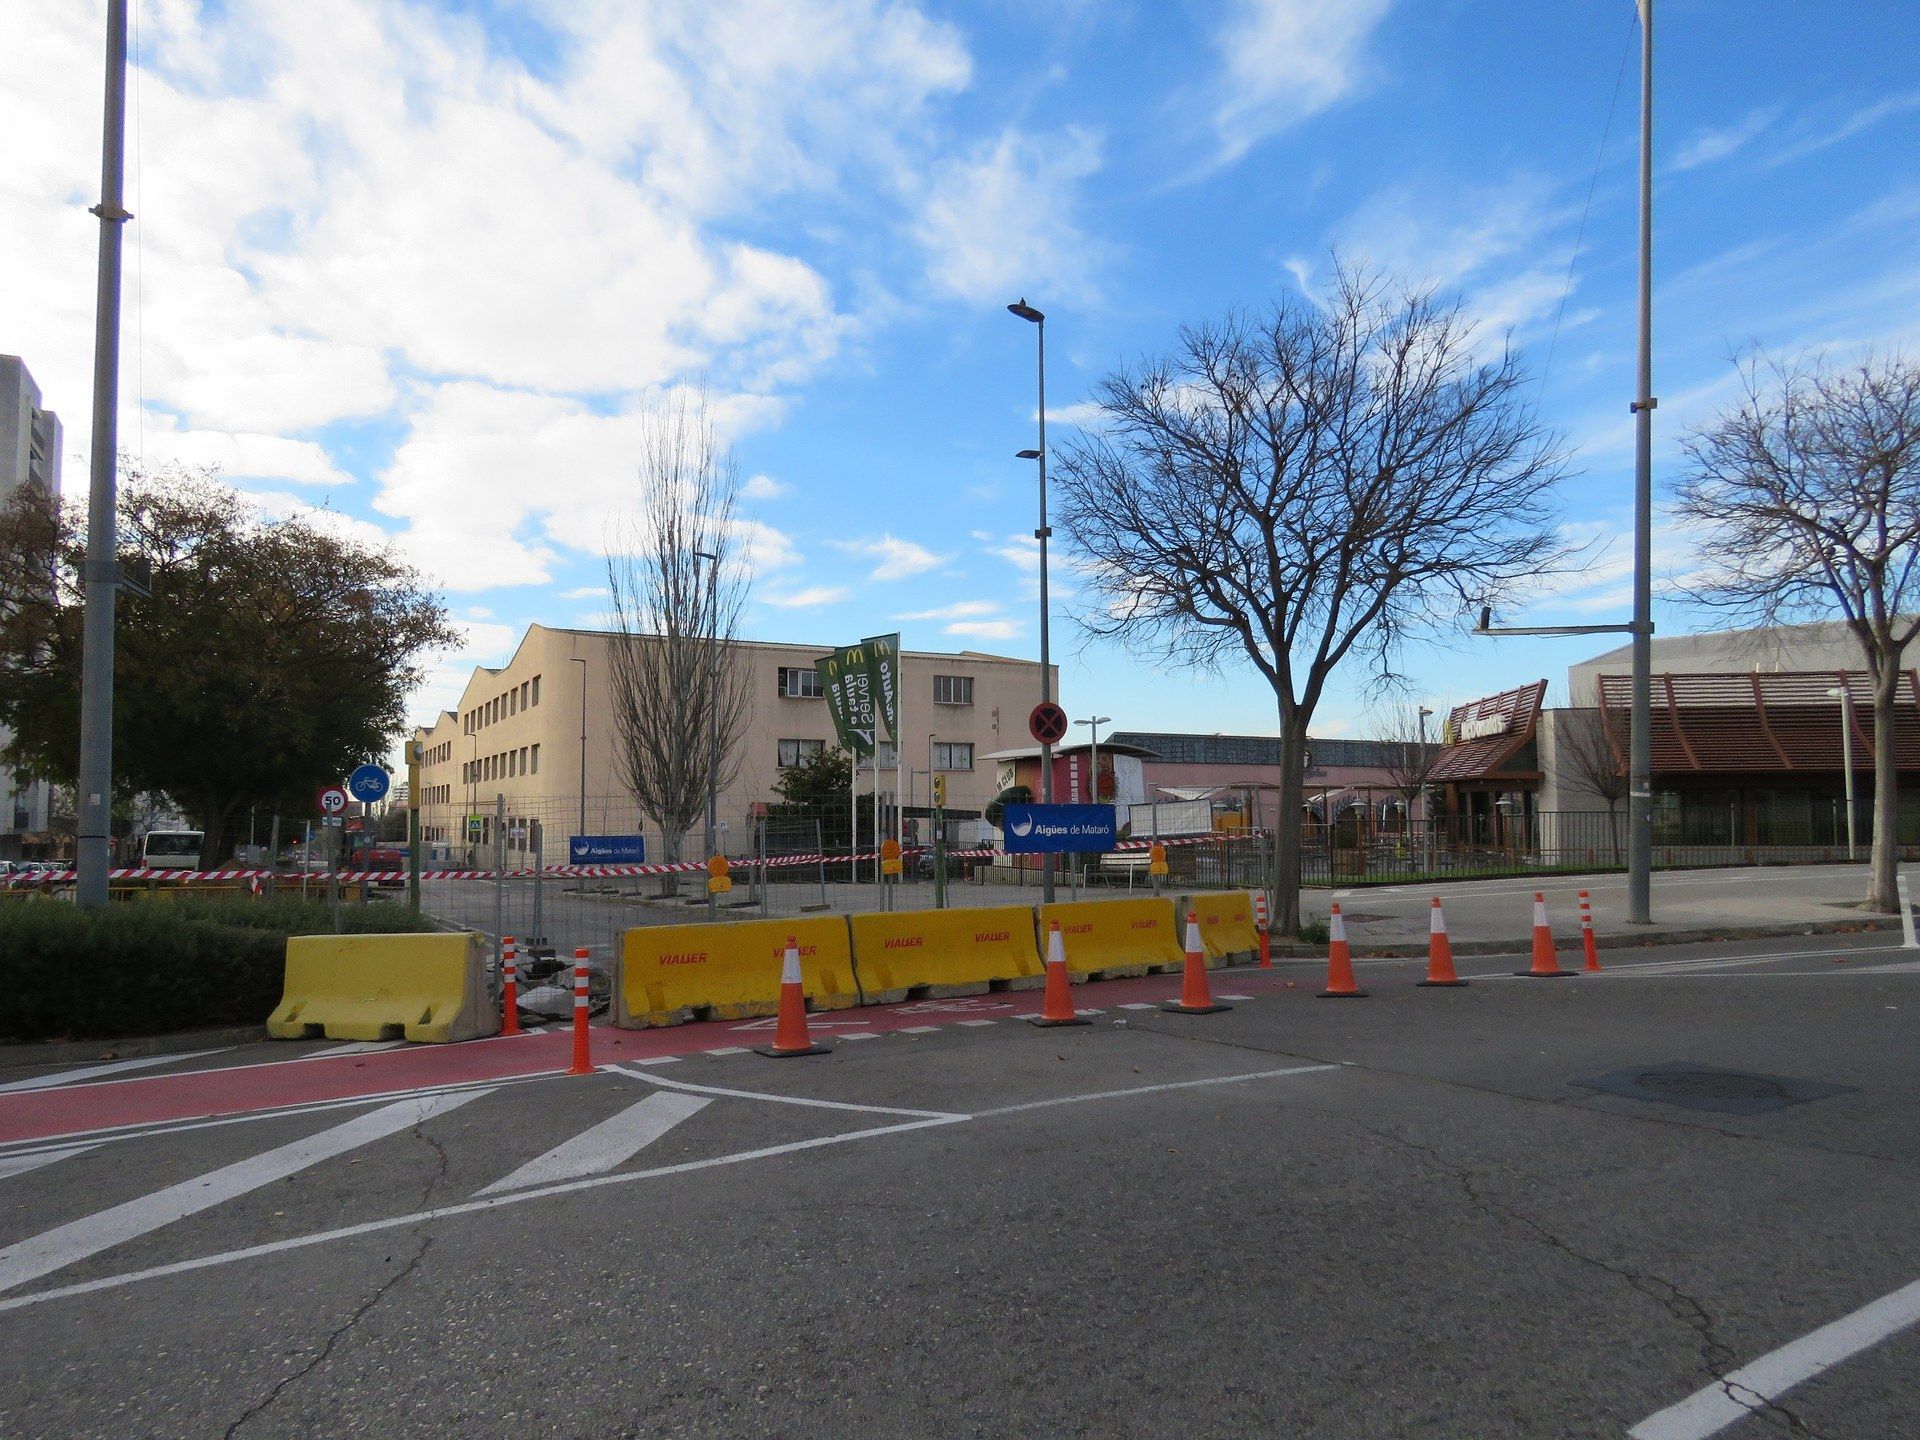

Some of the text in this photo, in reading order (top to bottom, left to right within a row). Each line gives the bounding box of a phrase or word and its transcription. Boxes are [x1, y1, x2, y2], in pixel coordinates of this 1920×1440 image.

[325, 796, 341, 806] 50
[1035, 823, 1110, 836] Aigües de Mataró
